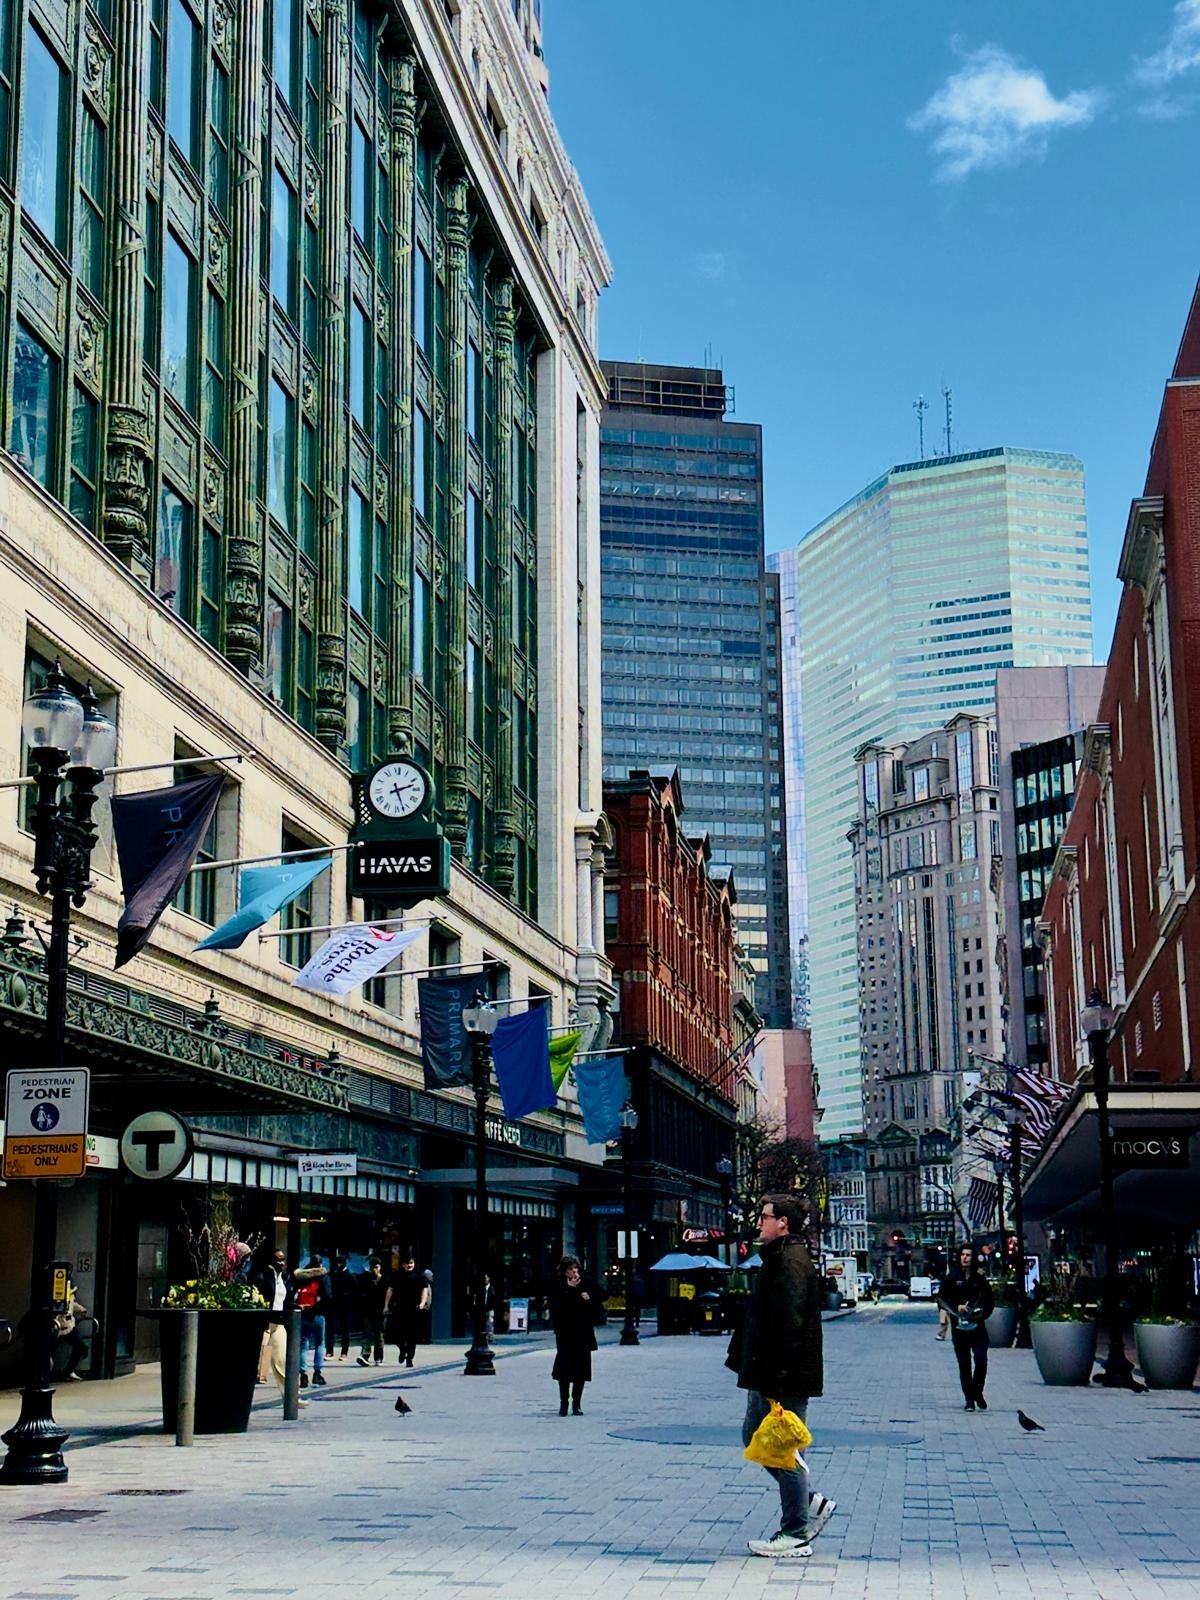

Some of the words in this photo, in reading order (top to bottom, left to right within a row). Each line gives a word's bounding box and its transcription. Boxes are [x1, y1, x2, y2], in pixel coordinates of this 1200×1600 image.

[360, 856, 432, 874] HAVAS
[324, 941, 380, 983] Roche
[447, 989, 463, 1077] PRIMARK
[21, 1078, 75, 1087] PEDESTRIAN
[23, 1088, 71, 1100] ZONE
[12, 1143, 79, 1155] PEDESTRIANS
[132, 1130, 176, 1171] T
[34, 1156, 59, 1167] ONLY
